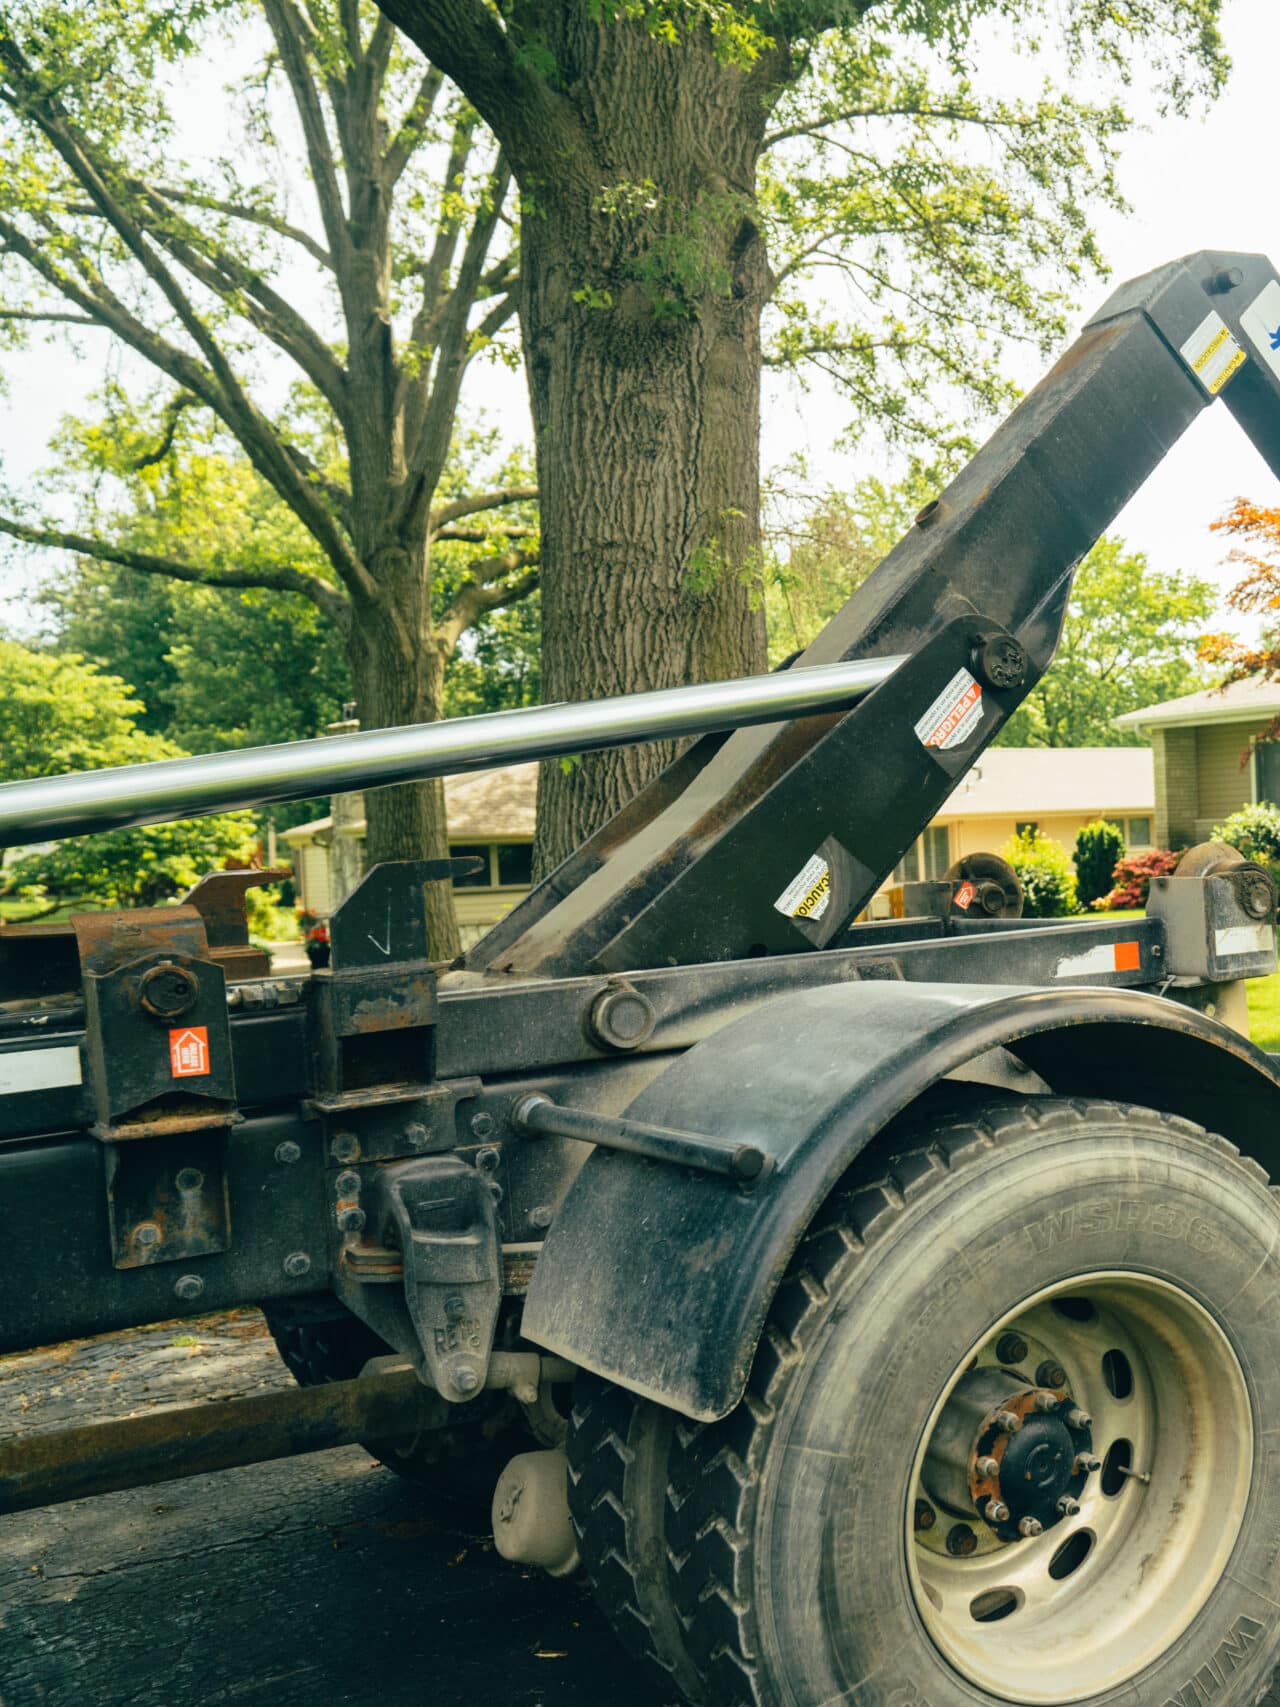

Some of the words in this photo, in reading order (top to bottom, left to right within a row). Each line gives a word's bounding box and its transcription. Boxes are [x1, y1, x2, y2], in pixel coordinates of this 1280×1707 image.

[929, 696, 973, 746] PELIGRO
[796, 873, 830, 916] CAUCIO
[1023, 1199, 1218, 1256] WSR36
